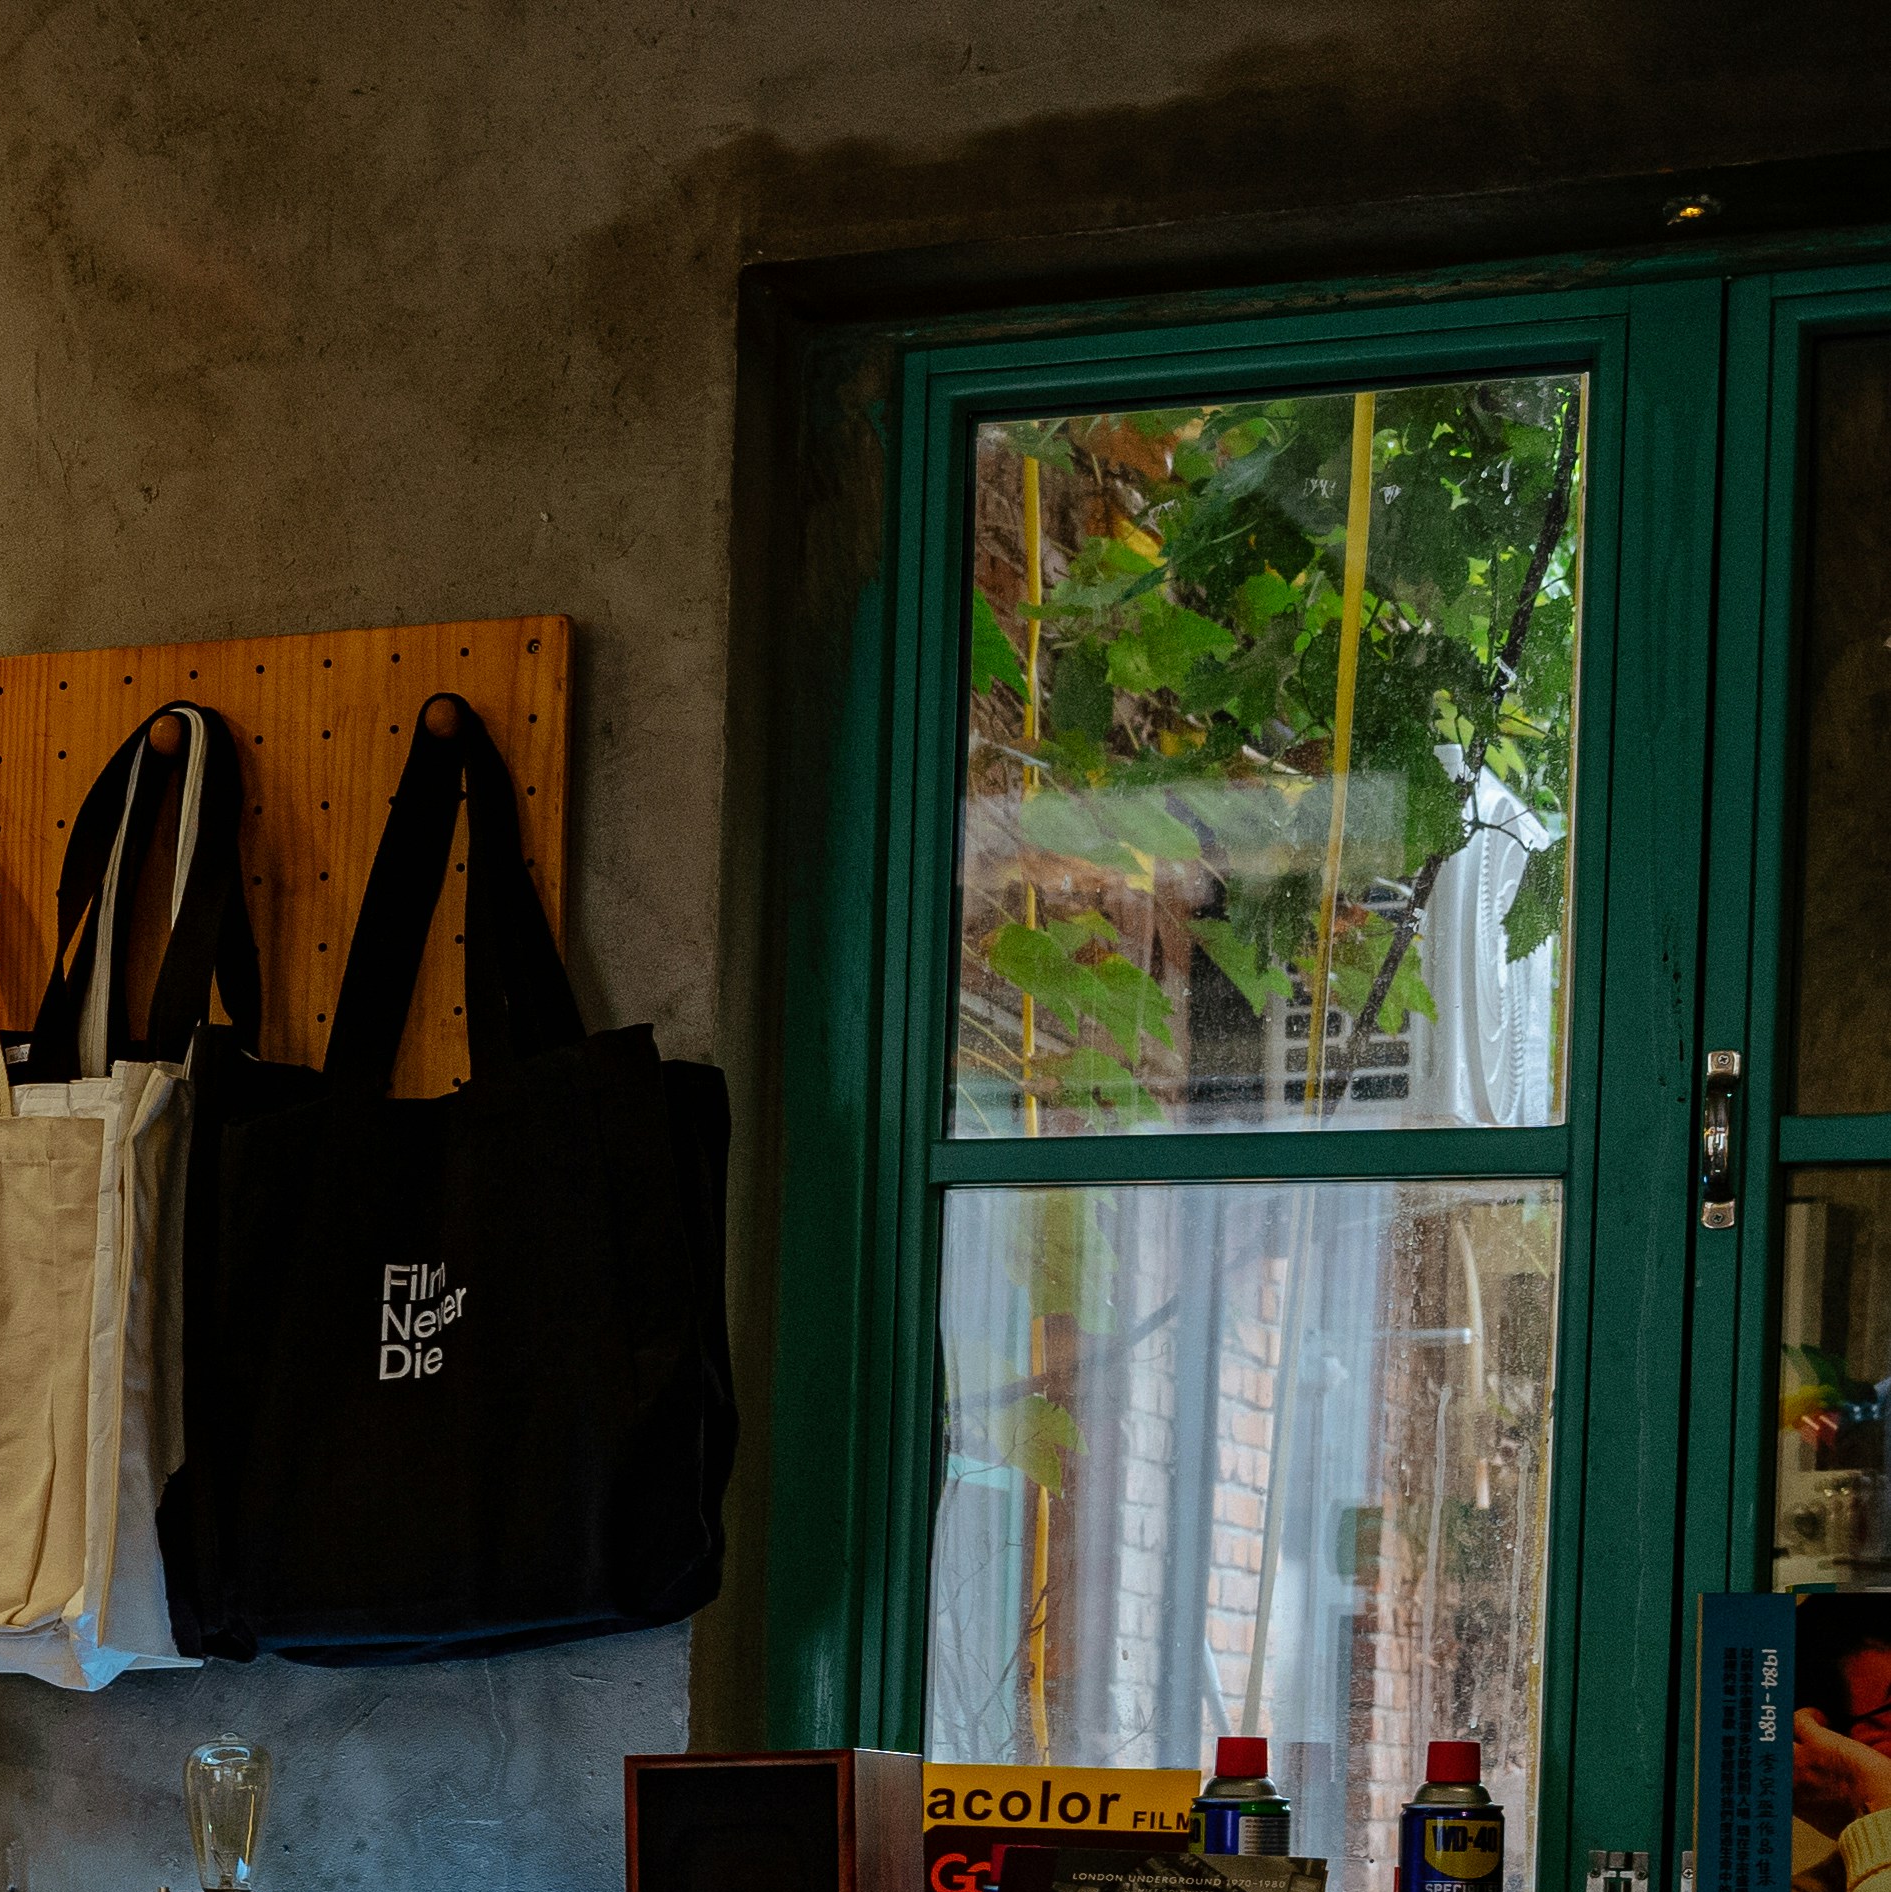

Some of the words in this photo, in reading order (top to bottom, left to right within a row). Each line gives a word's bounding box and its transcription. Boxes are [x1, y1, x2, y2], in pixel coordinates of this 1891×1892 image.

[383, 1261, 446, 1301] Film
[379, 1342, 444, 1381] Die
[925, 1780, 1123, 1825] acolor
[1132, 1809, 1193, 1831] FILM
[1431, 1824, 1501, 1855] WD-40
[1072, 1871, 1124, 1883] LONDON
[1127, 1874, 1222, 1888] UNDERGROUND
